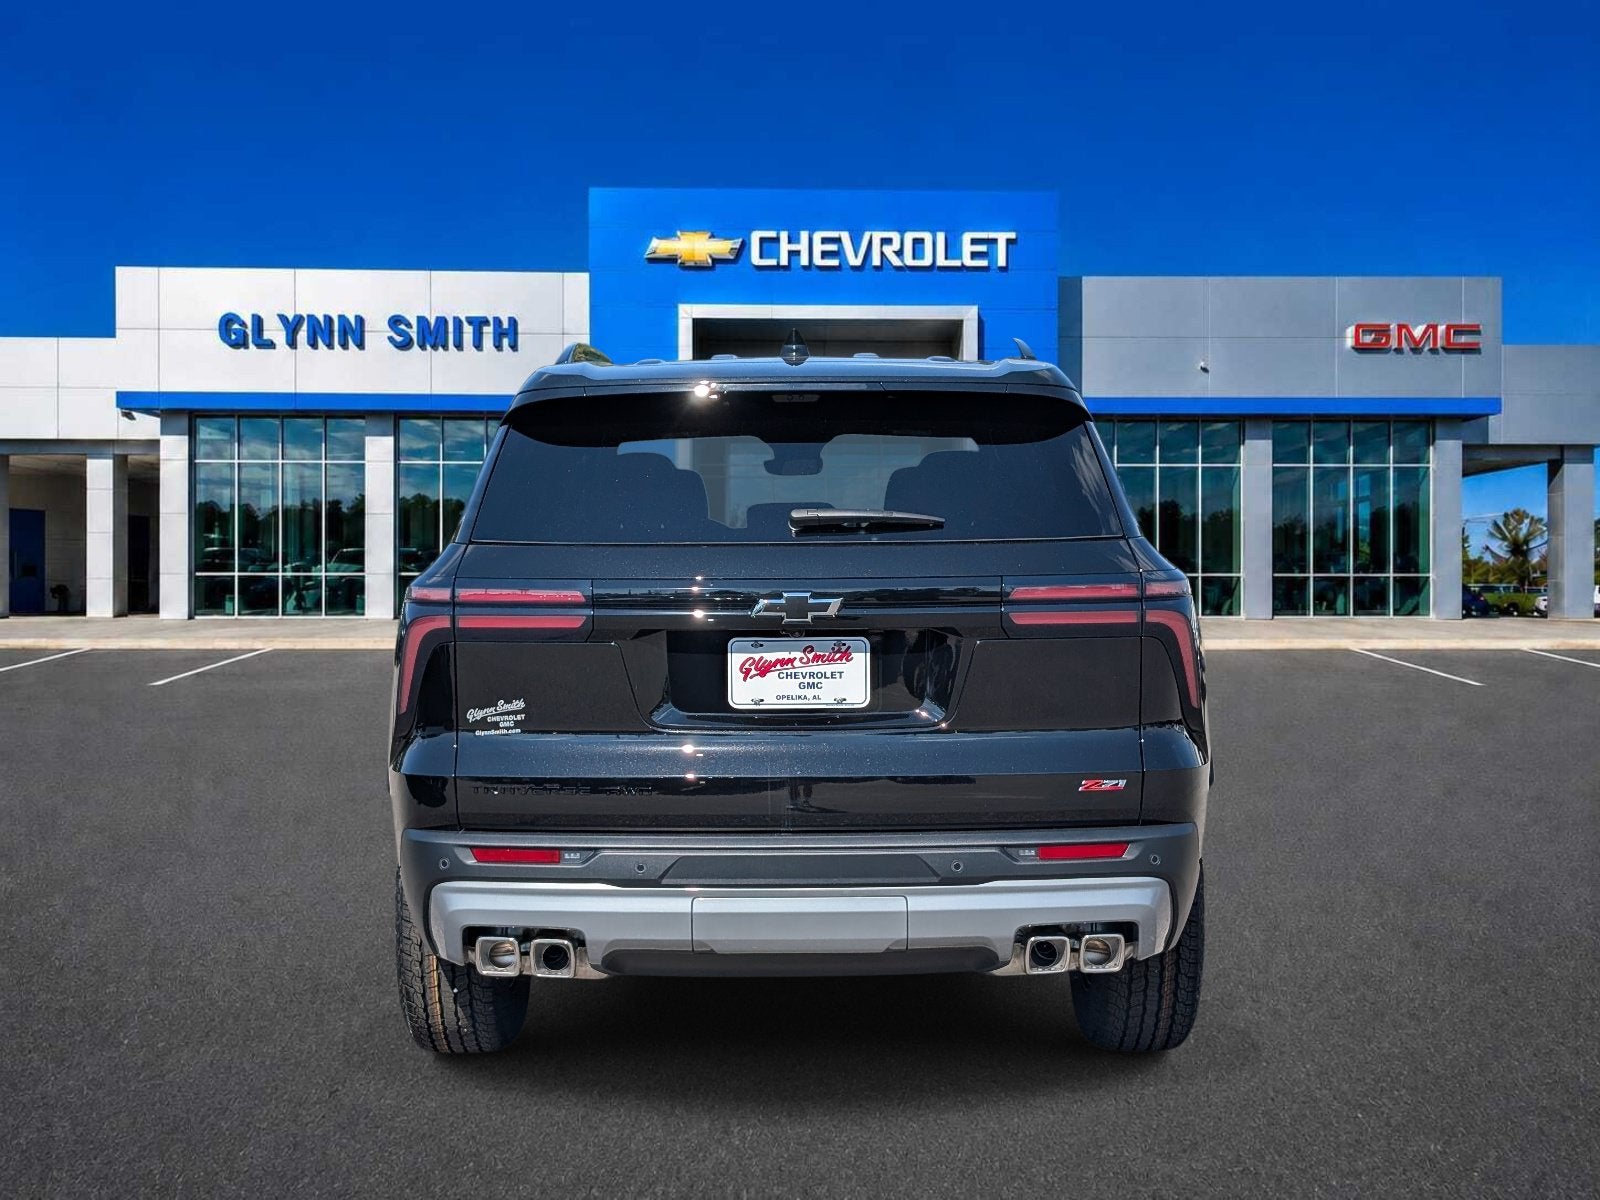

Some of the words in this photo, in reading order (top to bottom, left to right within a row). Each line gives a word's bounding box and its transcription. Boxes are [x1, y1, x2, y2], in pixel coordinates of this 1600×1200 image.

[750, 230, 1017, 270] CHEVROLET
[218, 311, 366, 350] GLYNN
[387, 313, 519, 351] SMITH
[1347, 322, 1482, 353] GMC
[740, 655, 797, 682] Glynn
[799, 644, 854, 665] Smith
[777, 671, 845, 680] CHEVROLET
[798, 681, 823, 690] GMC
[775, 694, 811, 702] OPELIKA,
[466, 707, 496, 723] Glynn
[496, 698, 526, 711] Smith
[487, 714, 526, 722] CHEVROLET
[1078, 779, 1127, 791] Z71
